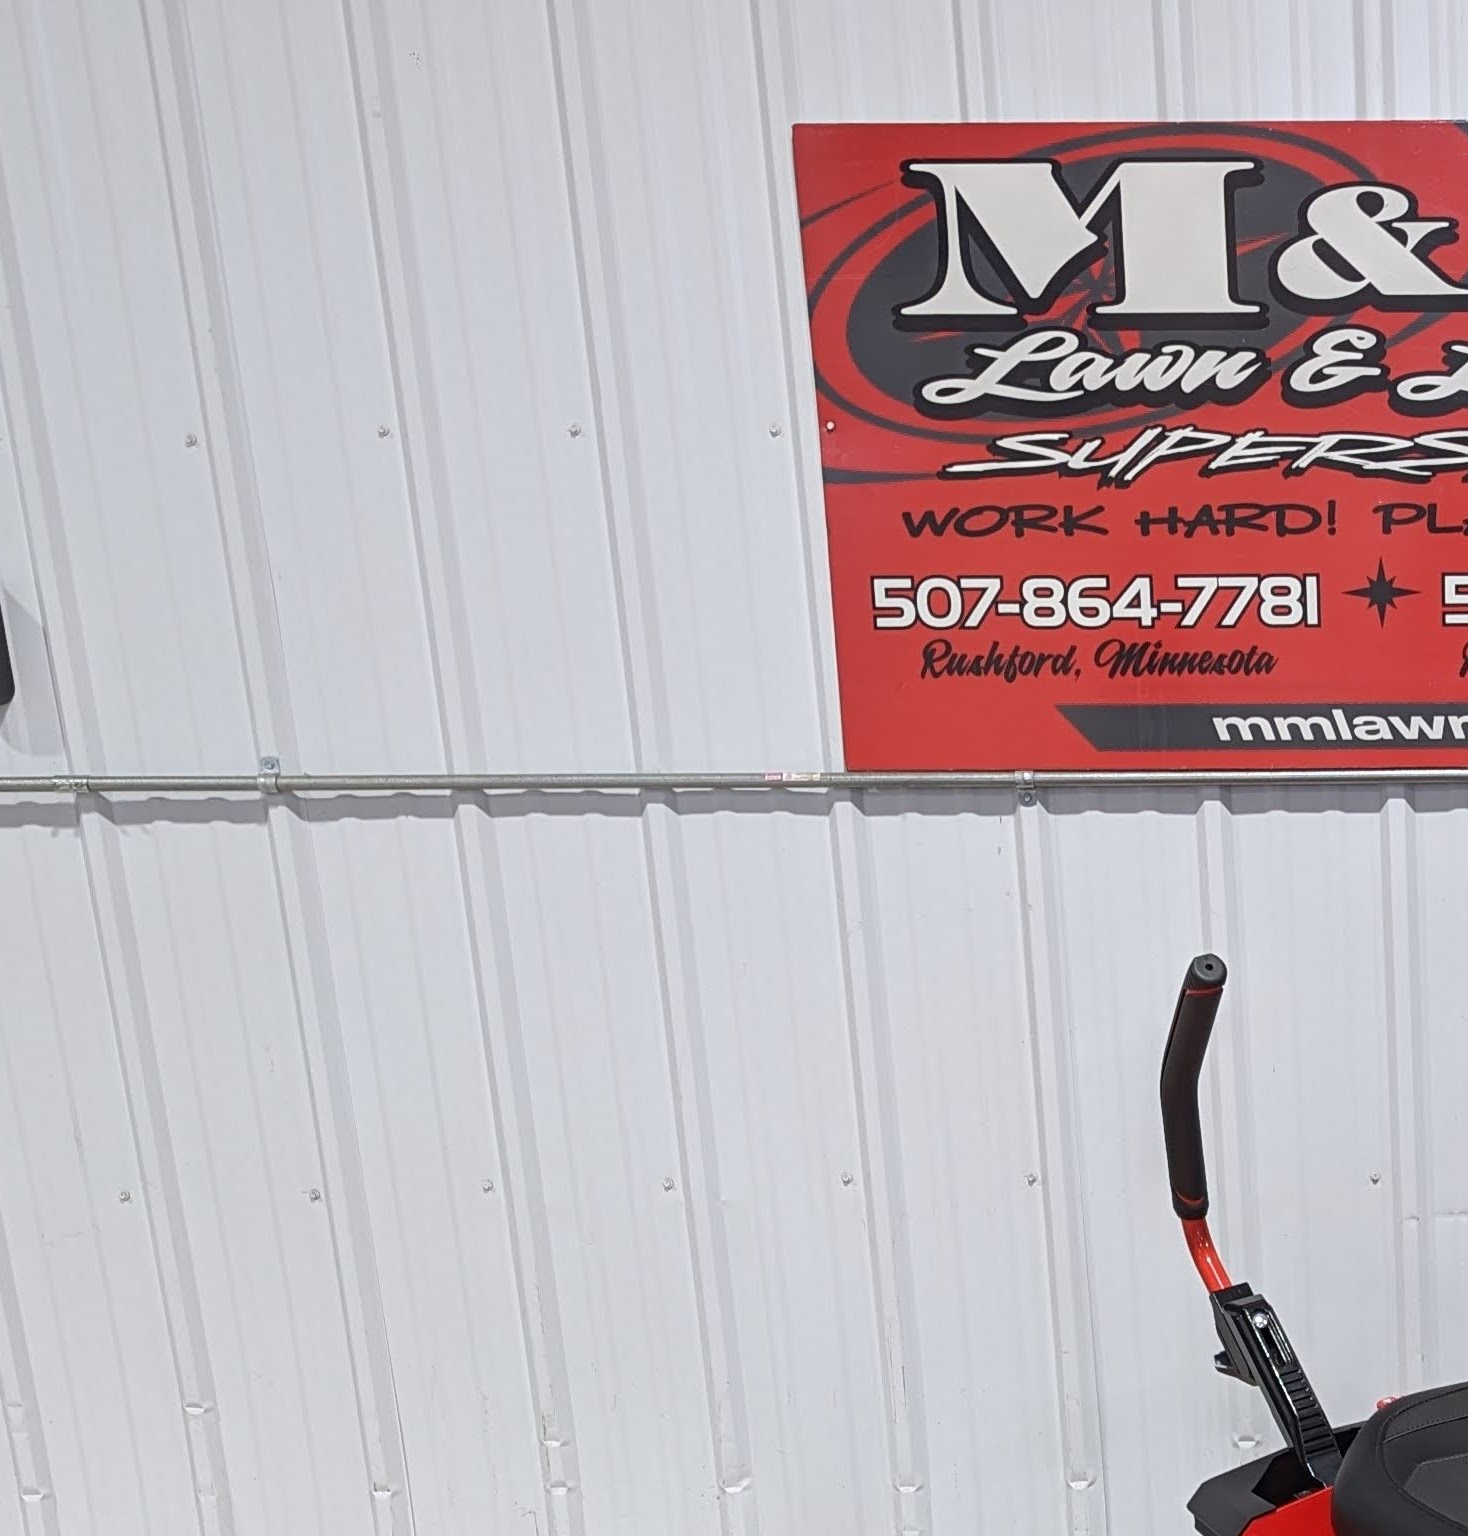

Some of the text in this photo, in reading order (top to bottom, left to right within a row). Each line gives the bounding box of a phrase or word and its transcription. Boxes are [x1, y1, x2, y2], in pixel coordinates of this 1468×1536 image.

[918, 328, 1264, 410] Lawn
[1286, 327, 1383, 395] &
[900, 503, 1109, 539] WORK
[1134, 499, 1337, 539] HARD!
[872, 574, 1321, 629] 507-864-7781
[920, 637, 1279, 684] Rushford, Minnesota
